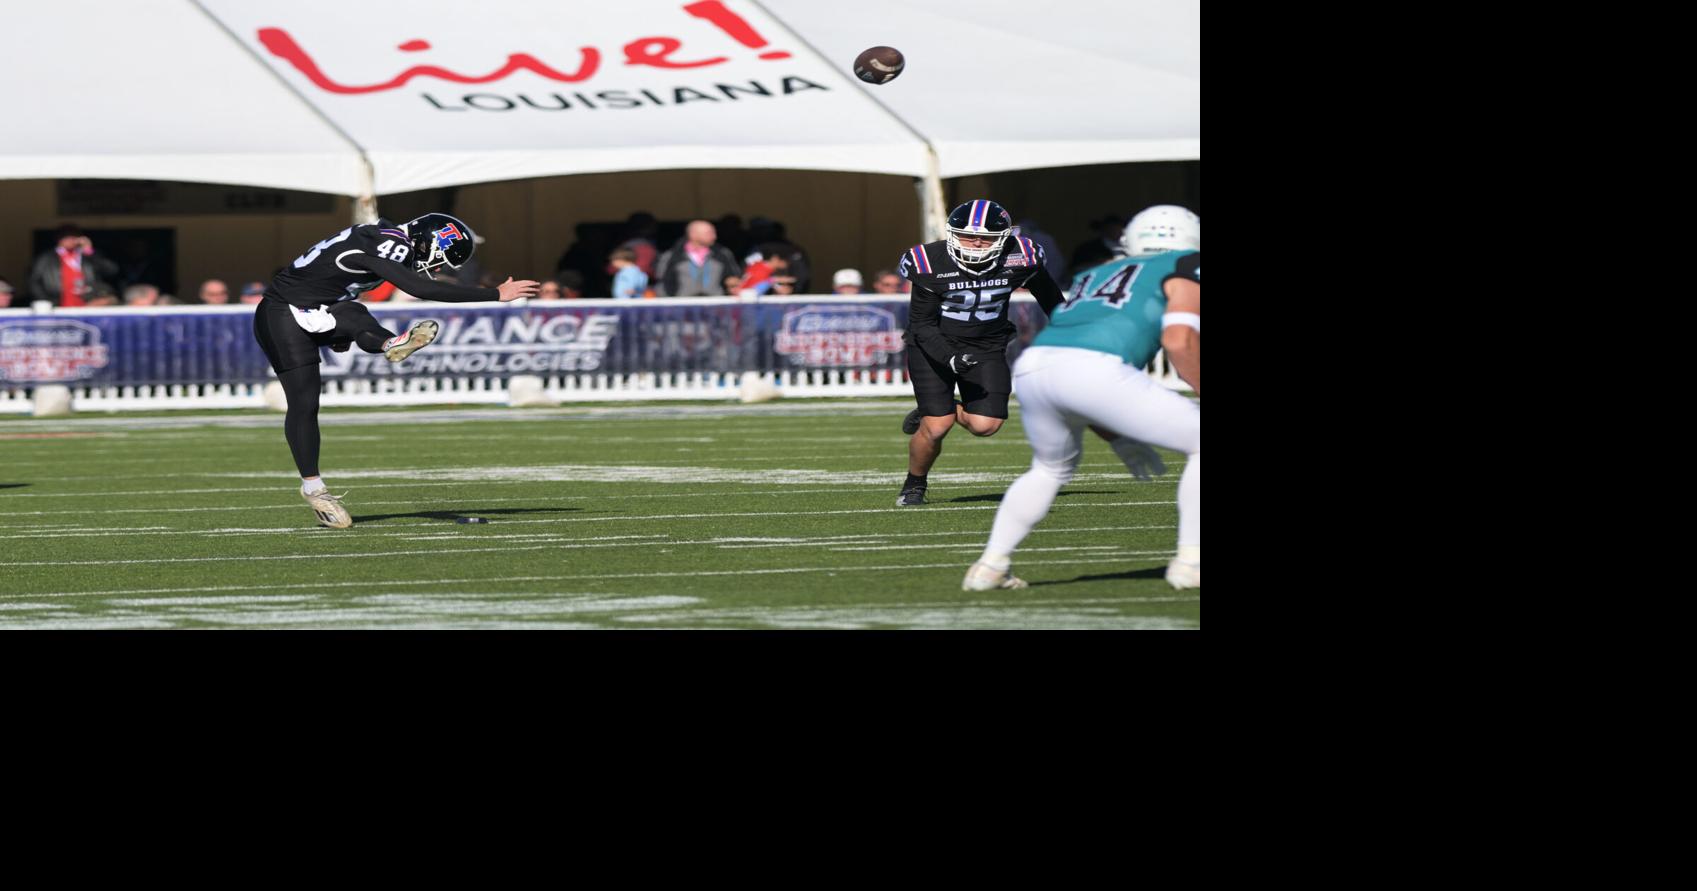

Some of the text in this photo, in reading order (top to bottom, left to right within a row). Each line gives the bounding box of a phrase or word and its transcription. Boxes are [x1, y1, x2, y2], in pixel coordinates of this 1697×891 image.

[257, 0, 793, 95] Live!
[422, 74, 831, 112] LOUISIANA
[376, 239, 409, 263] 48
[948, 278, 1009, 291] BULLDOGS
[940, 287, 1013, 322] 25
[378, 314, 620, 344] IANCE
[354, 350, 601, 374] TECHNOLOGIES
